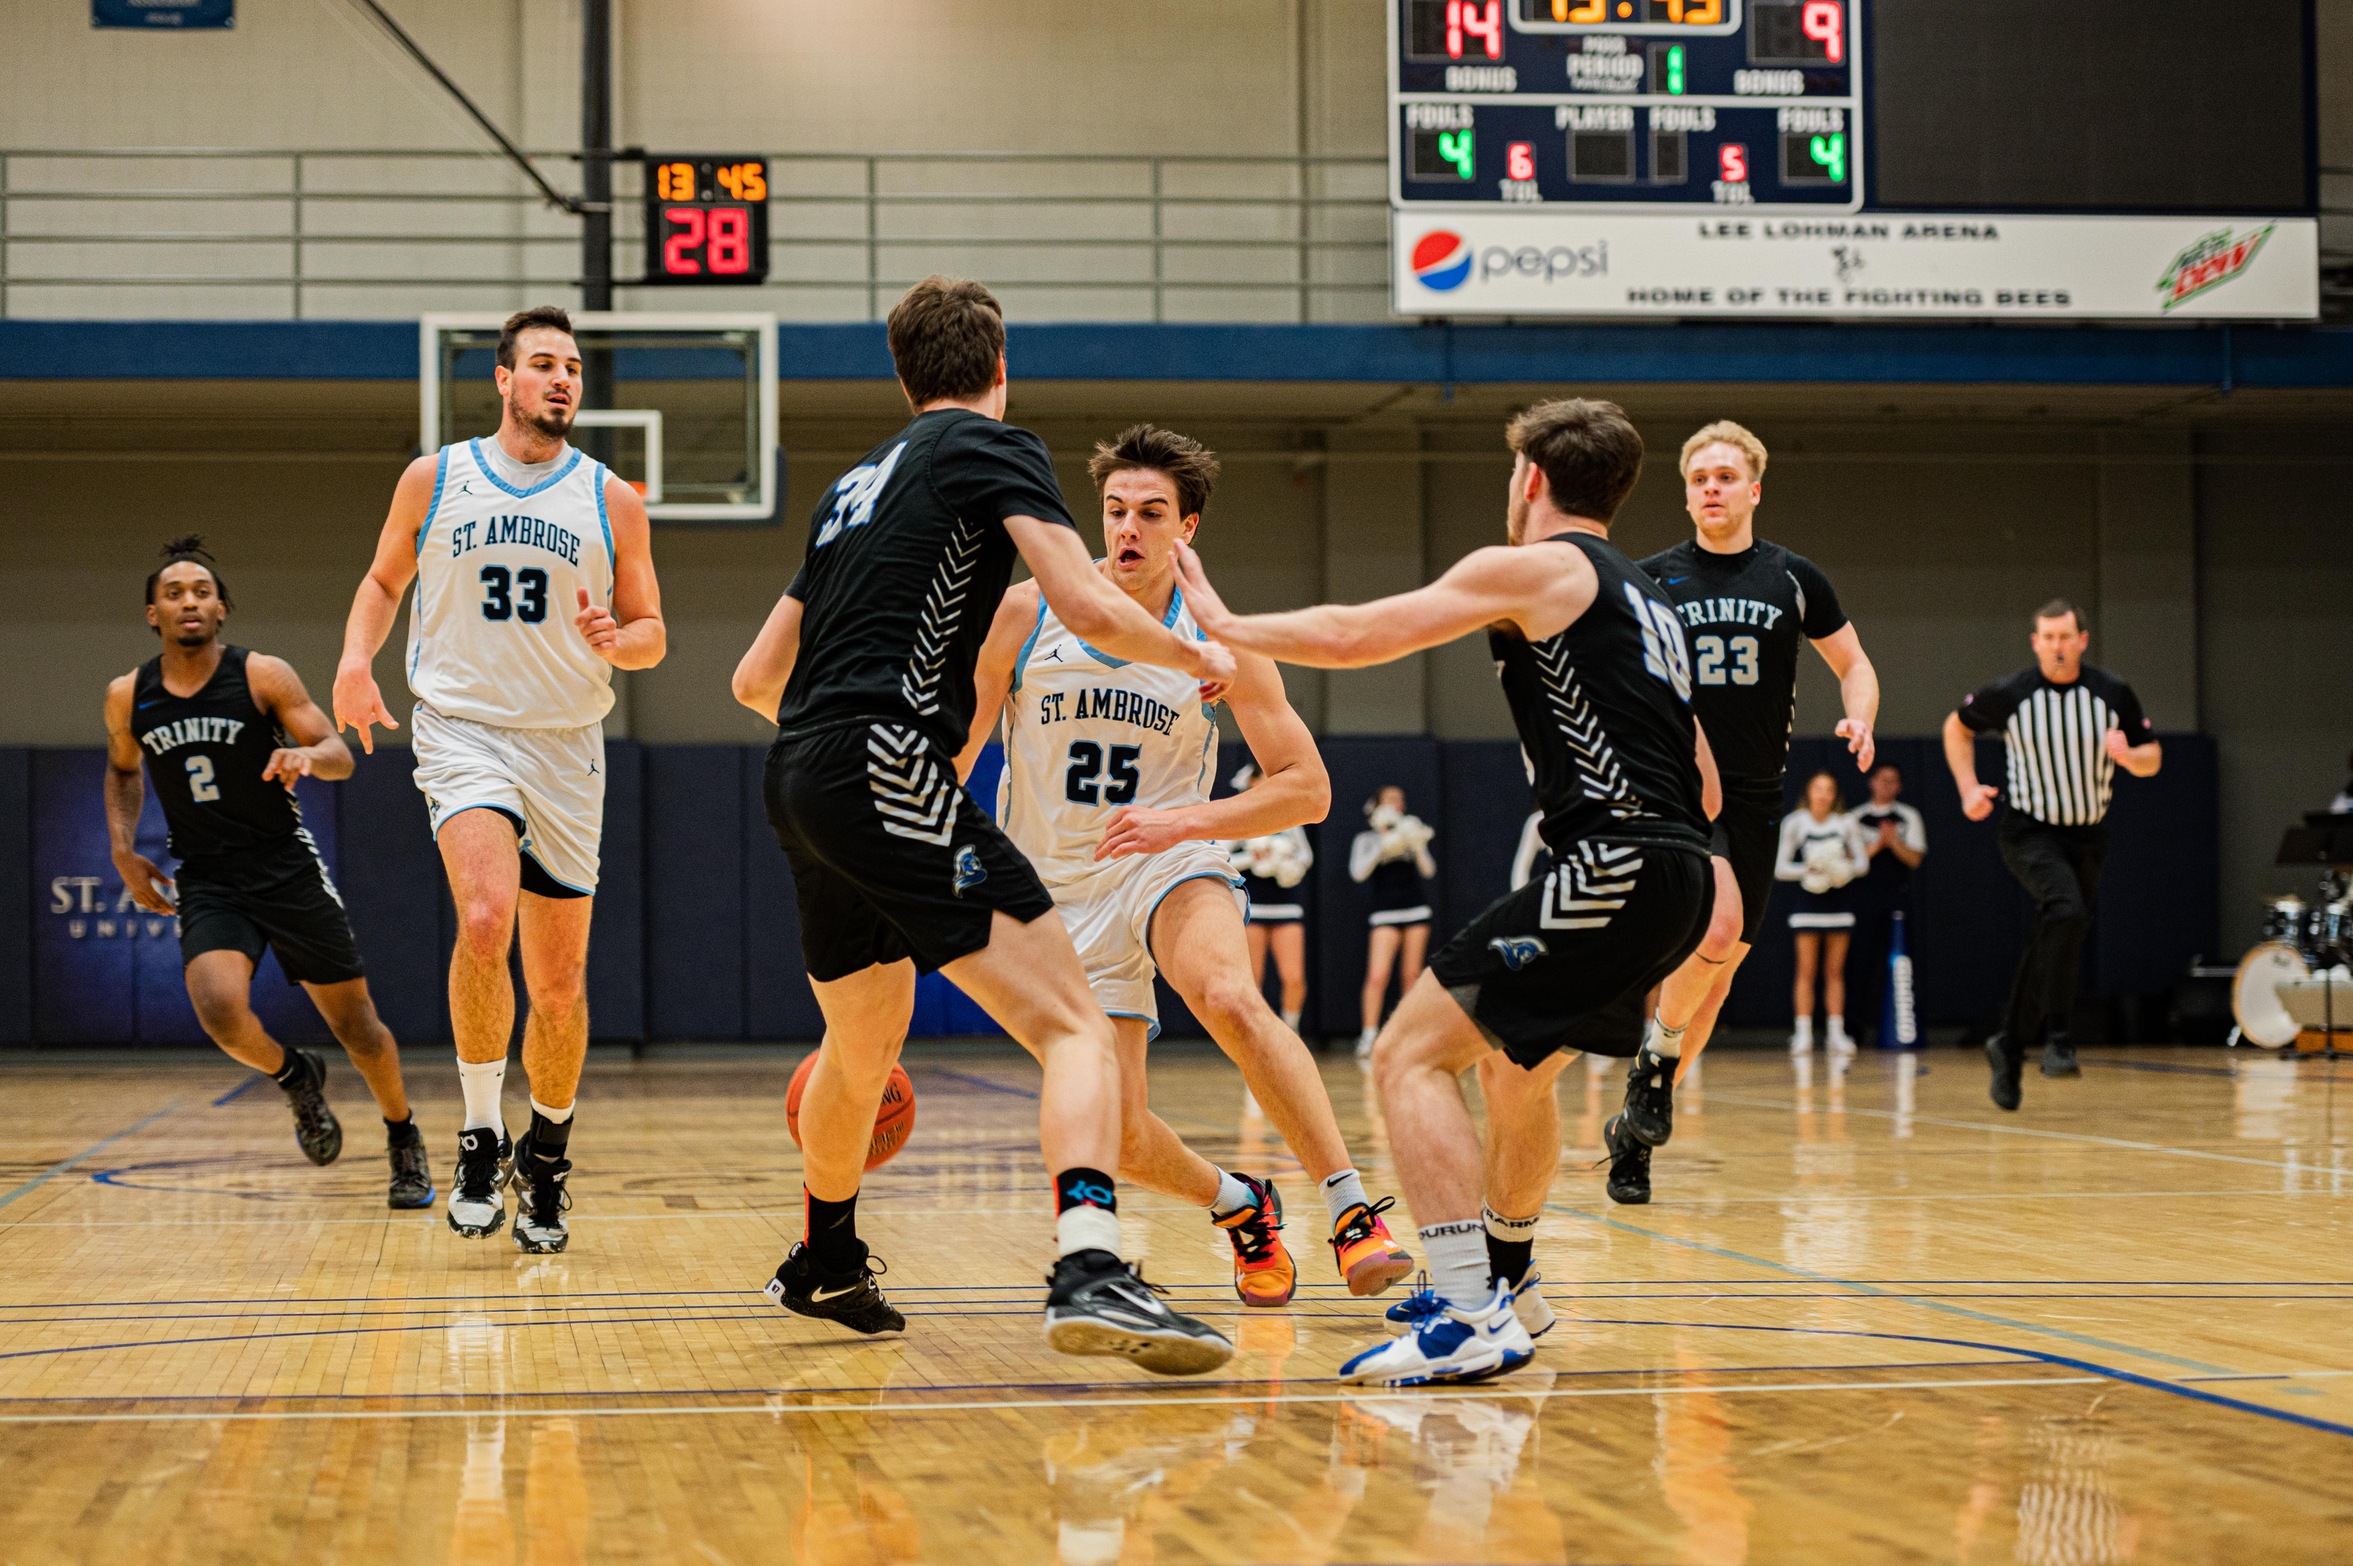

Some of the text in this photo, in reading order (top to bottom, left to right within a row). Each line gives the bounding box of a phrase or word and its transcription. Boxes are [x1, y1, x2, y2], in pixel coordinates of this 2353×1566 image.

[1446, 0, 1501, 59] 14
[1802, 0, 1843, 63] 9
[1445, 66, 1517, 92] BONUS
[1567, 54, 1644, 79] PERIOD
[1667, 46, 1683, 96] 1
[1734, 69, 1805, 95] BONUS
[1406, 104, 1474, 129] FOULS
[1555, 105, 1716, 131] PLAYER FOULS
[1777, 107, 1844, 132] FOULS
[1439, 128, 1473, 180] 4
[1507, 143, 1534, 181] 6
[1720, 145, 1747, 183] 5
[1810, 132, 1844, 182] 4
[665, 208, 749, 275] 28
[1699, 221, 1998, 240] LEE LOHMAN ARENA
[1480, 239, 1608, 284] pepsi
[1627, 289, 2071, 307] HOME OF THE FIGHTING BEES
[815, 440, 909, 549] 34
[453, 515, 580, 567] ST. AMBROSE
[479, 564, 549, 625] 33
[1623, 580, 1692, 703] 10
[1695, 635, 1760, 686] 23
[1041, 688, 1180, 736] ST. AMBROSE
[141, 717, 245, 756] TRINITY
[185, 755, 220, 802] 2
[1065, 739, 1143, 807] 25
[50, 876, 107, 914] ST.
